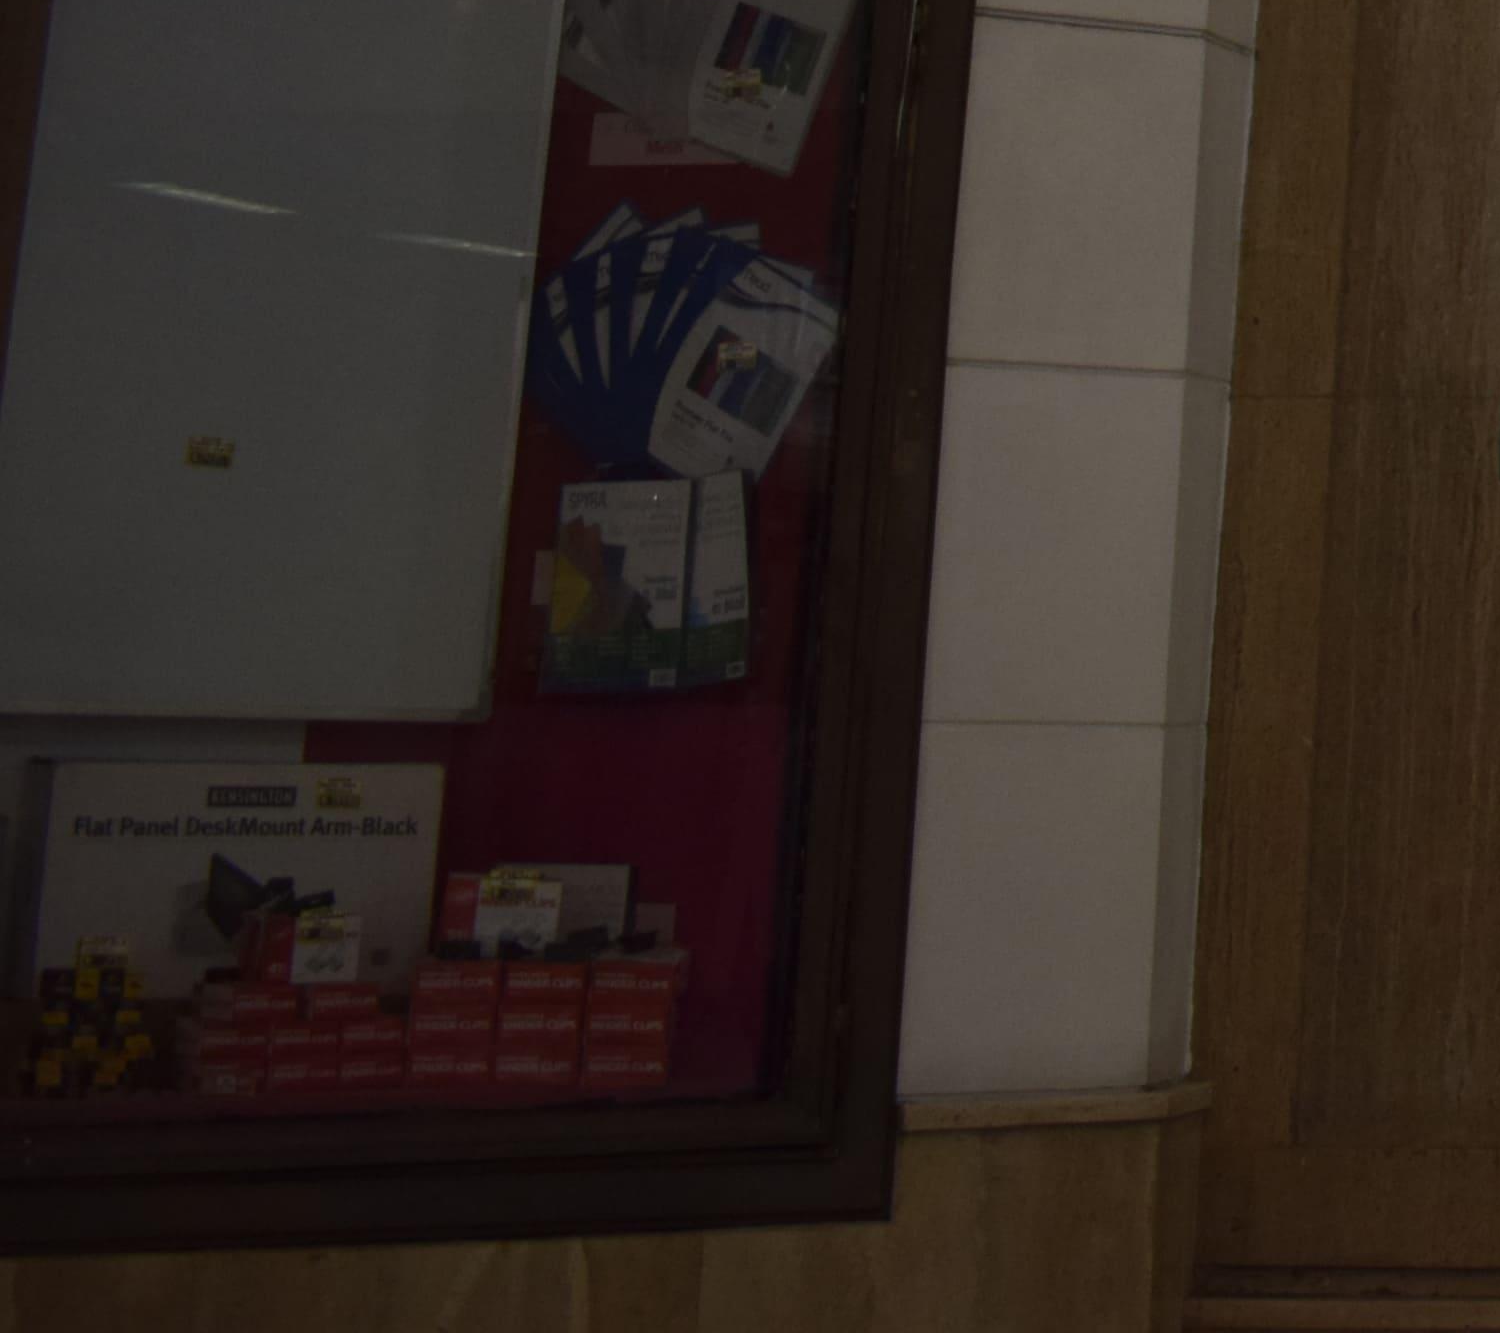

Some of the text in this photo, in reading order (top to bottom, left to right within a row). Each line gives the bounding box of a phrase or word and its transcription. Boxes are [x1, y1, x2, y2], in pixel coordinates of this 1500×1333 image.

[210, 787, 295, 806] KENSINGTON
[74, 815, 418, 837] Flat Panel DeskMount Arm-Black
